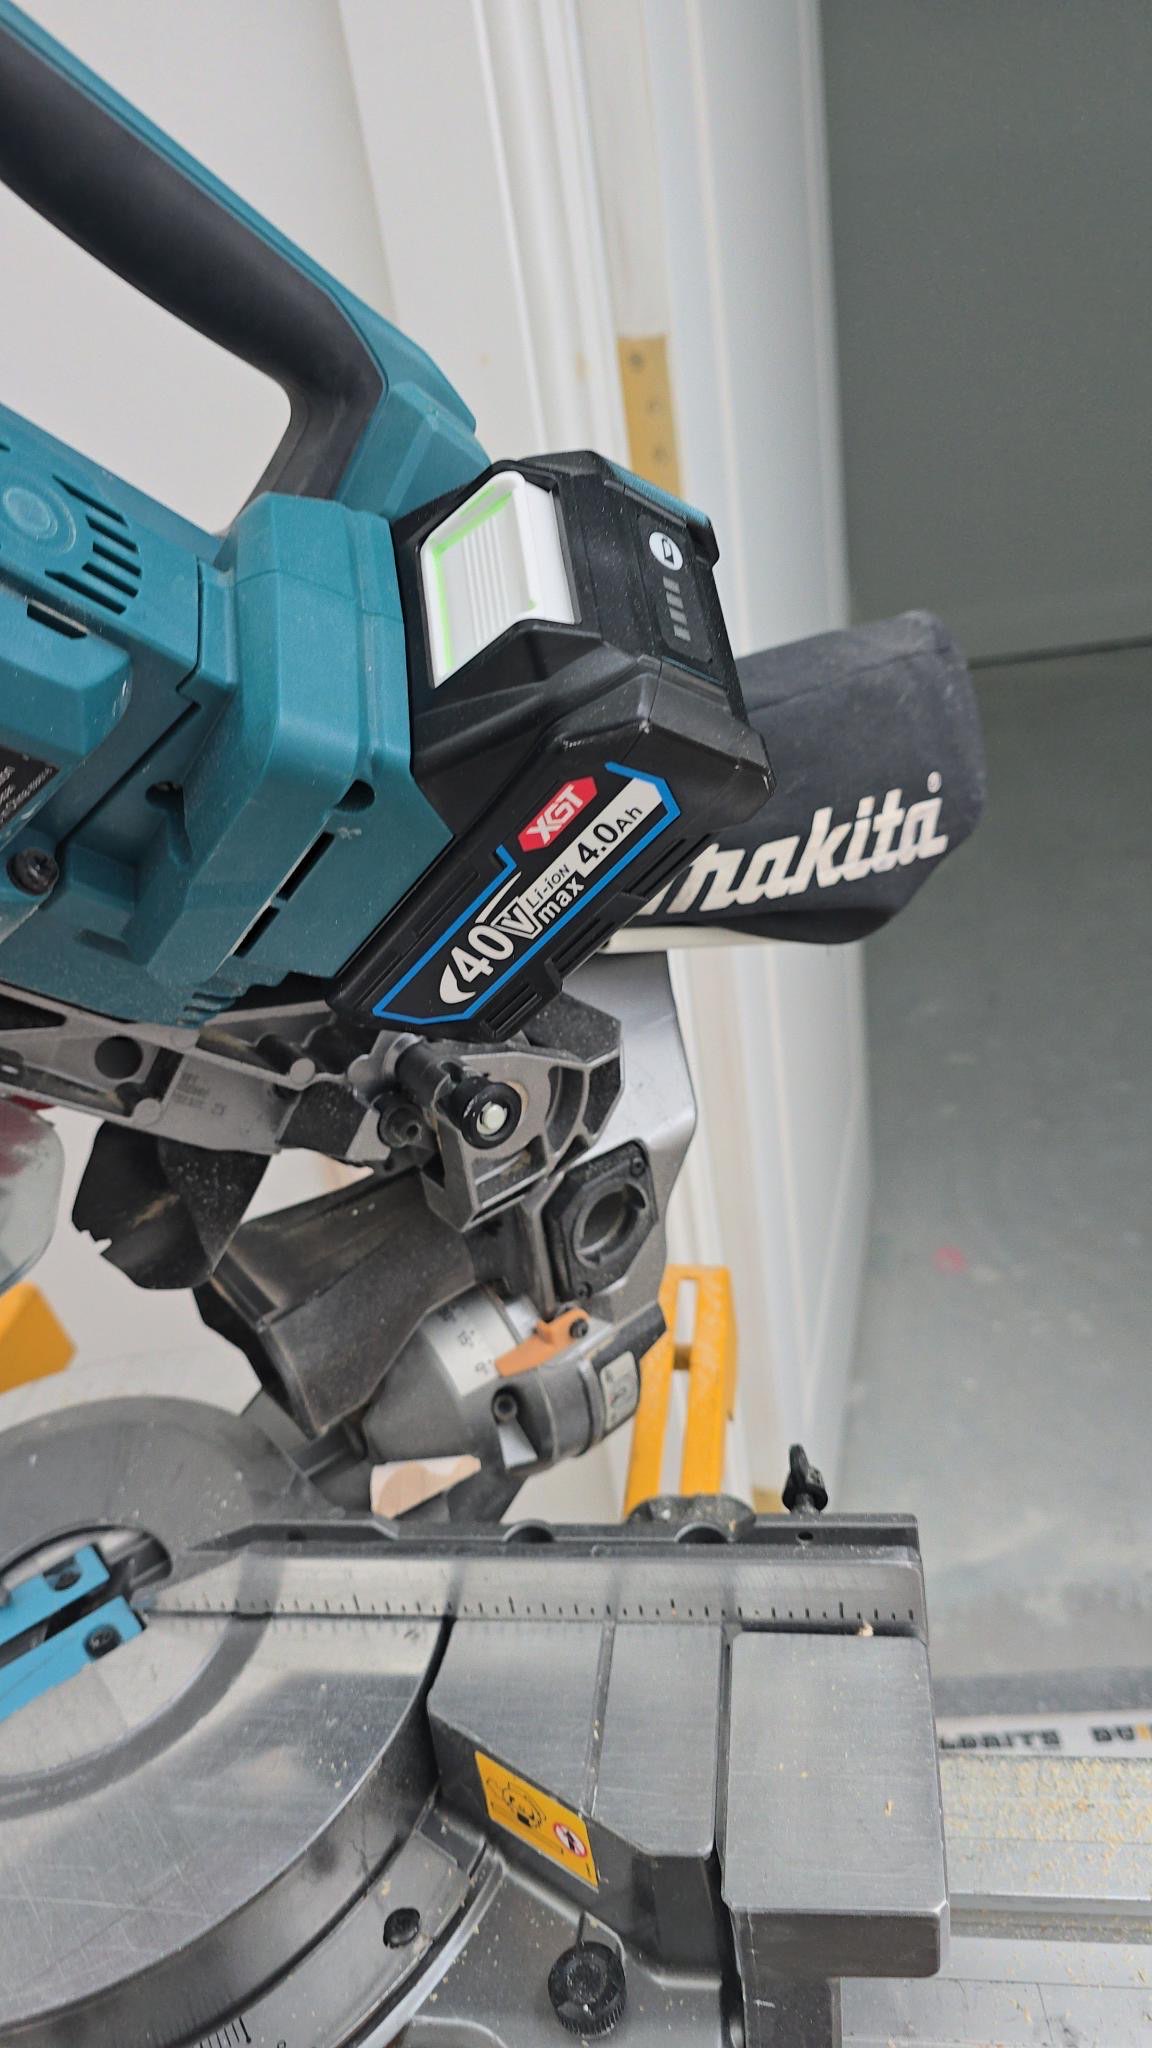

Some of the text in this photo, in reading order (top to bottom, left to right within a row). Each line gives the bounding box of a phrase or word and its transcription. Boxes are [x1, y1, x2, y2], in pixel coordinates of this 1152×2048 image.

[525, 783, 584, 845] XGT
[577, 806, 644, 866] 4.0Ah
[536, 877, 586, 925] max
